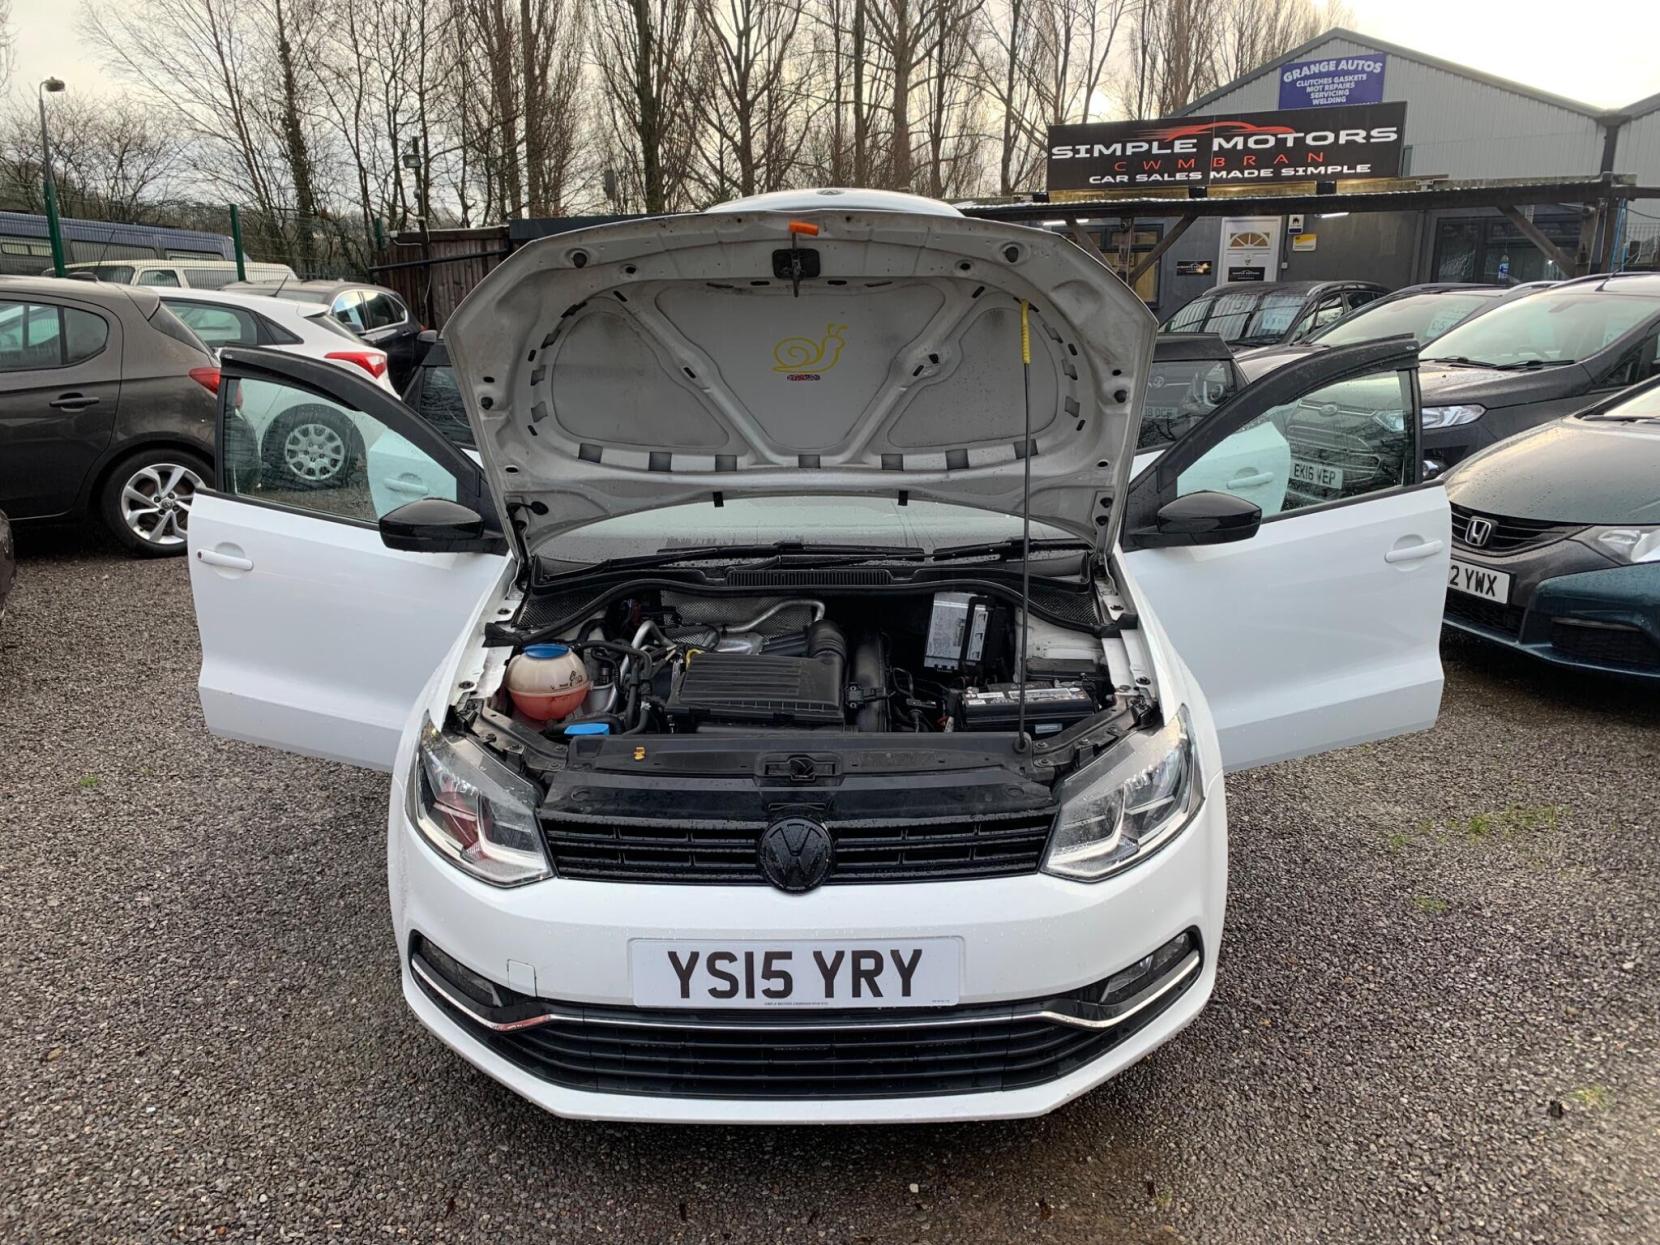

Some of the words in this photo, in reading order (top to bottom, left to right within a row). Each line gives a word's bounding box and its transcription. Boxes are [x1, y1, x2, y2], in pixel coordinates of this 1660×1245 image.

[1283, 61, 1336, 82] GRANGE
[1338, 59, 1383, 73] AUTOS
[1296, 77, 1332, 87] CLUTCHES
[1333, 73, 1367, 83] GASKETS
[1306, 85, 1323, 93] MOT
[1324, 82, 1355, 91] REPAIRS
[1310, 89, 1349, 99] SERVICING
[1312, 96, 1347, 105] WELDING
[1051, 139, 1197, 160] SIMPLE
[1212, 127, 1398, 151] MOTORS
[1114, 152, 1324, 172] CWMBRAN
[1089, 175, 1129, 184] CAR
[1135, 171, 1202, 182] SALES
[1210, 168, 1274, 179] MADE
[1281, 164, 1372, 176] SIMPLE
[1294, 463, 1314, 480] EK16
[1465, 568, 1497, 597] YWX
[667, 950, 793, 999] YS15
[813, 948, 923, 998] YRY
